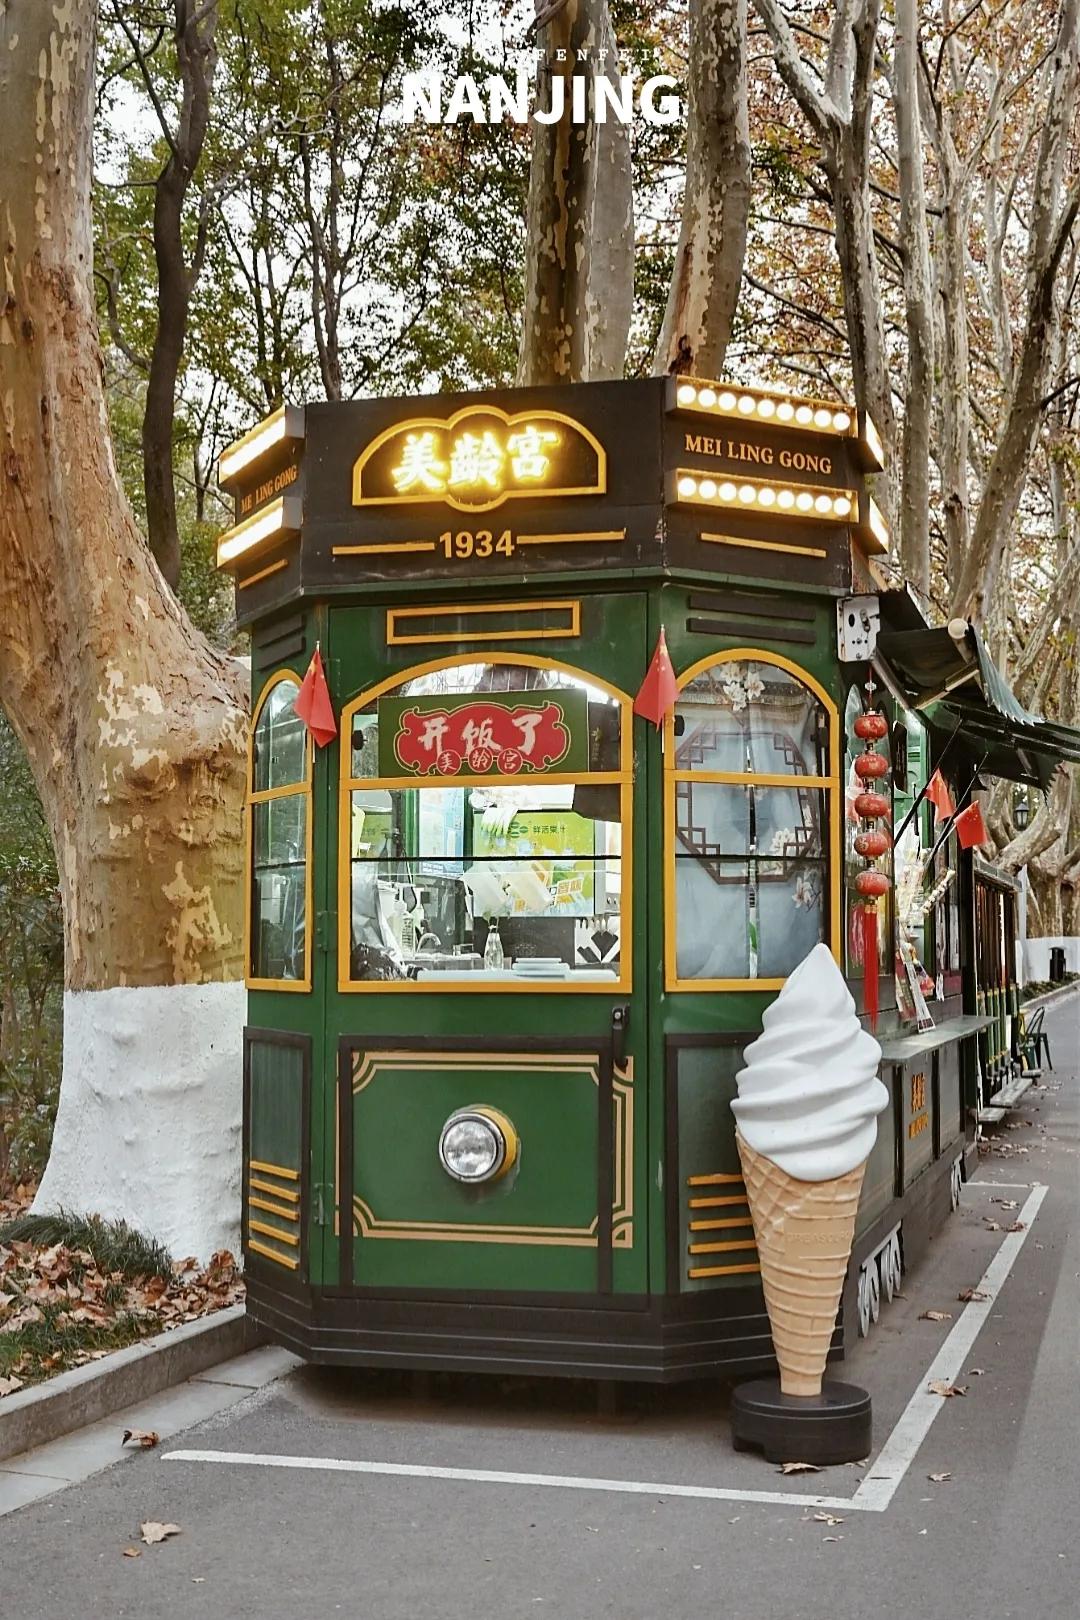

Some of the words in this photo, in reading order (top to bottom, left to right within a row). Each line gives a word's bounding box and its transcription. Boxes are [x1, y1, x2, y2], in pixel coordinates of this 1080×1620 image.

[685, 434, 722, 457] MEI
[727, 441, 774, 465] LING
[779, 450, 832, 474] GONG
[255, 479, 274, 505] LING
[274, 464, 297, 492] GONG
[439, 530, 515, 558] 1934
[417, 713, 543, 757] 开饭了
